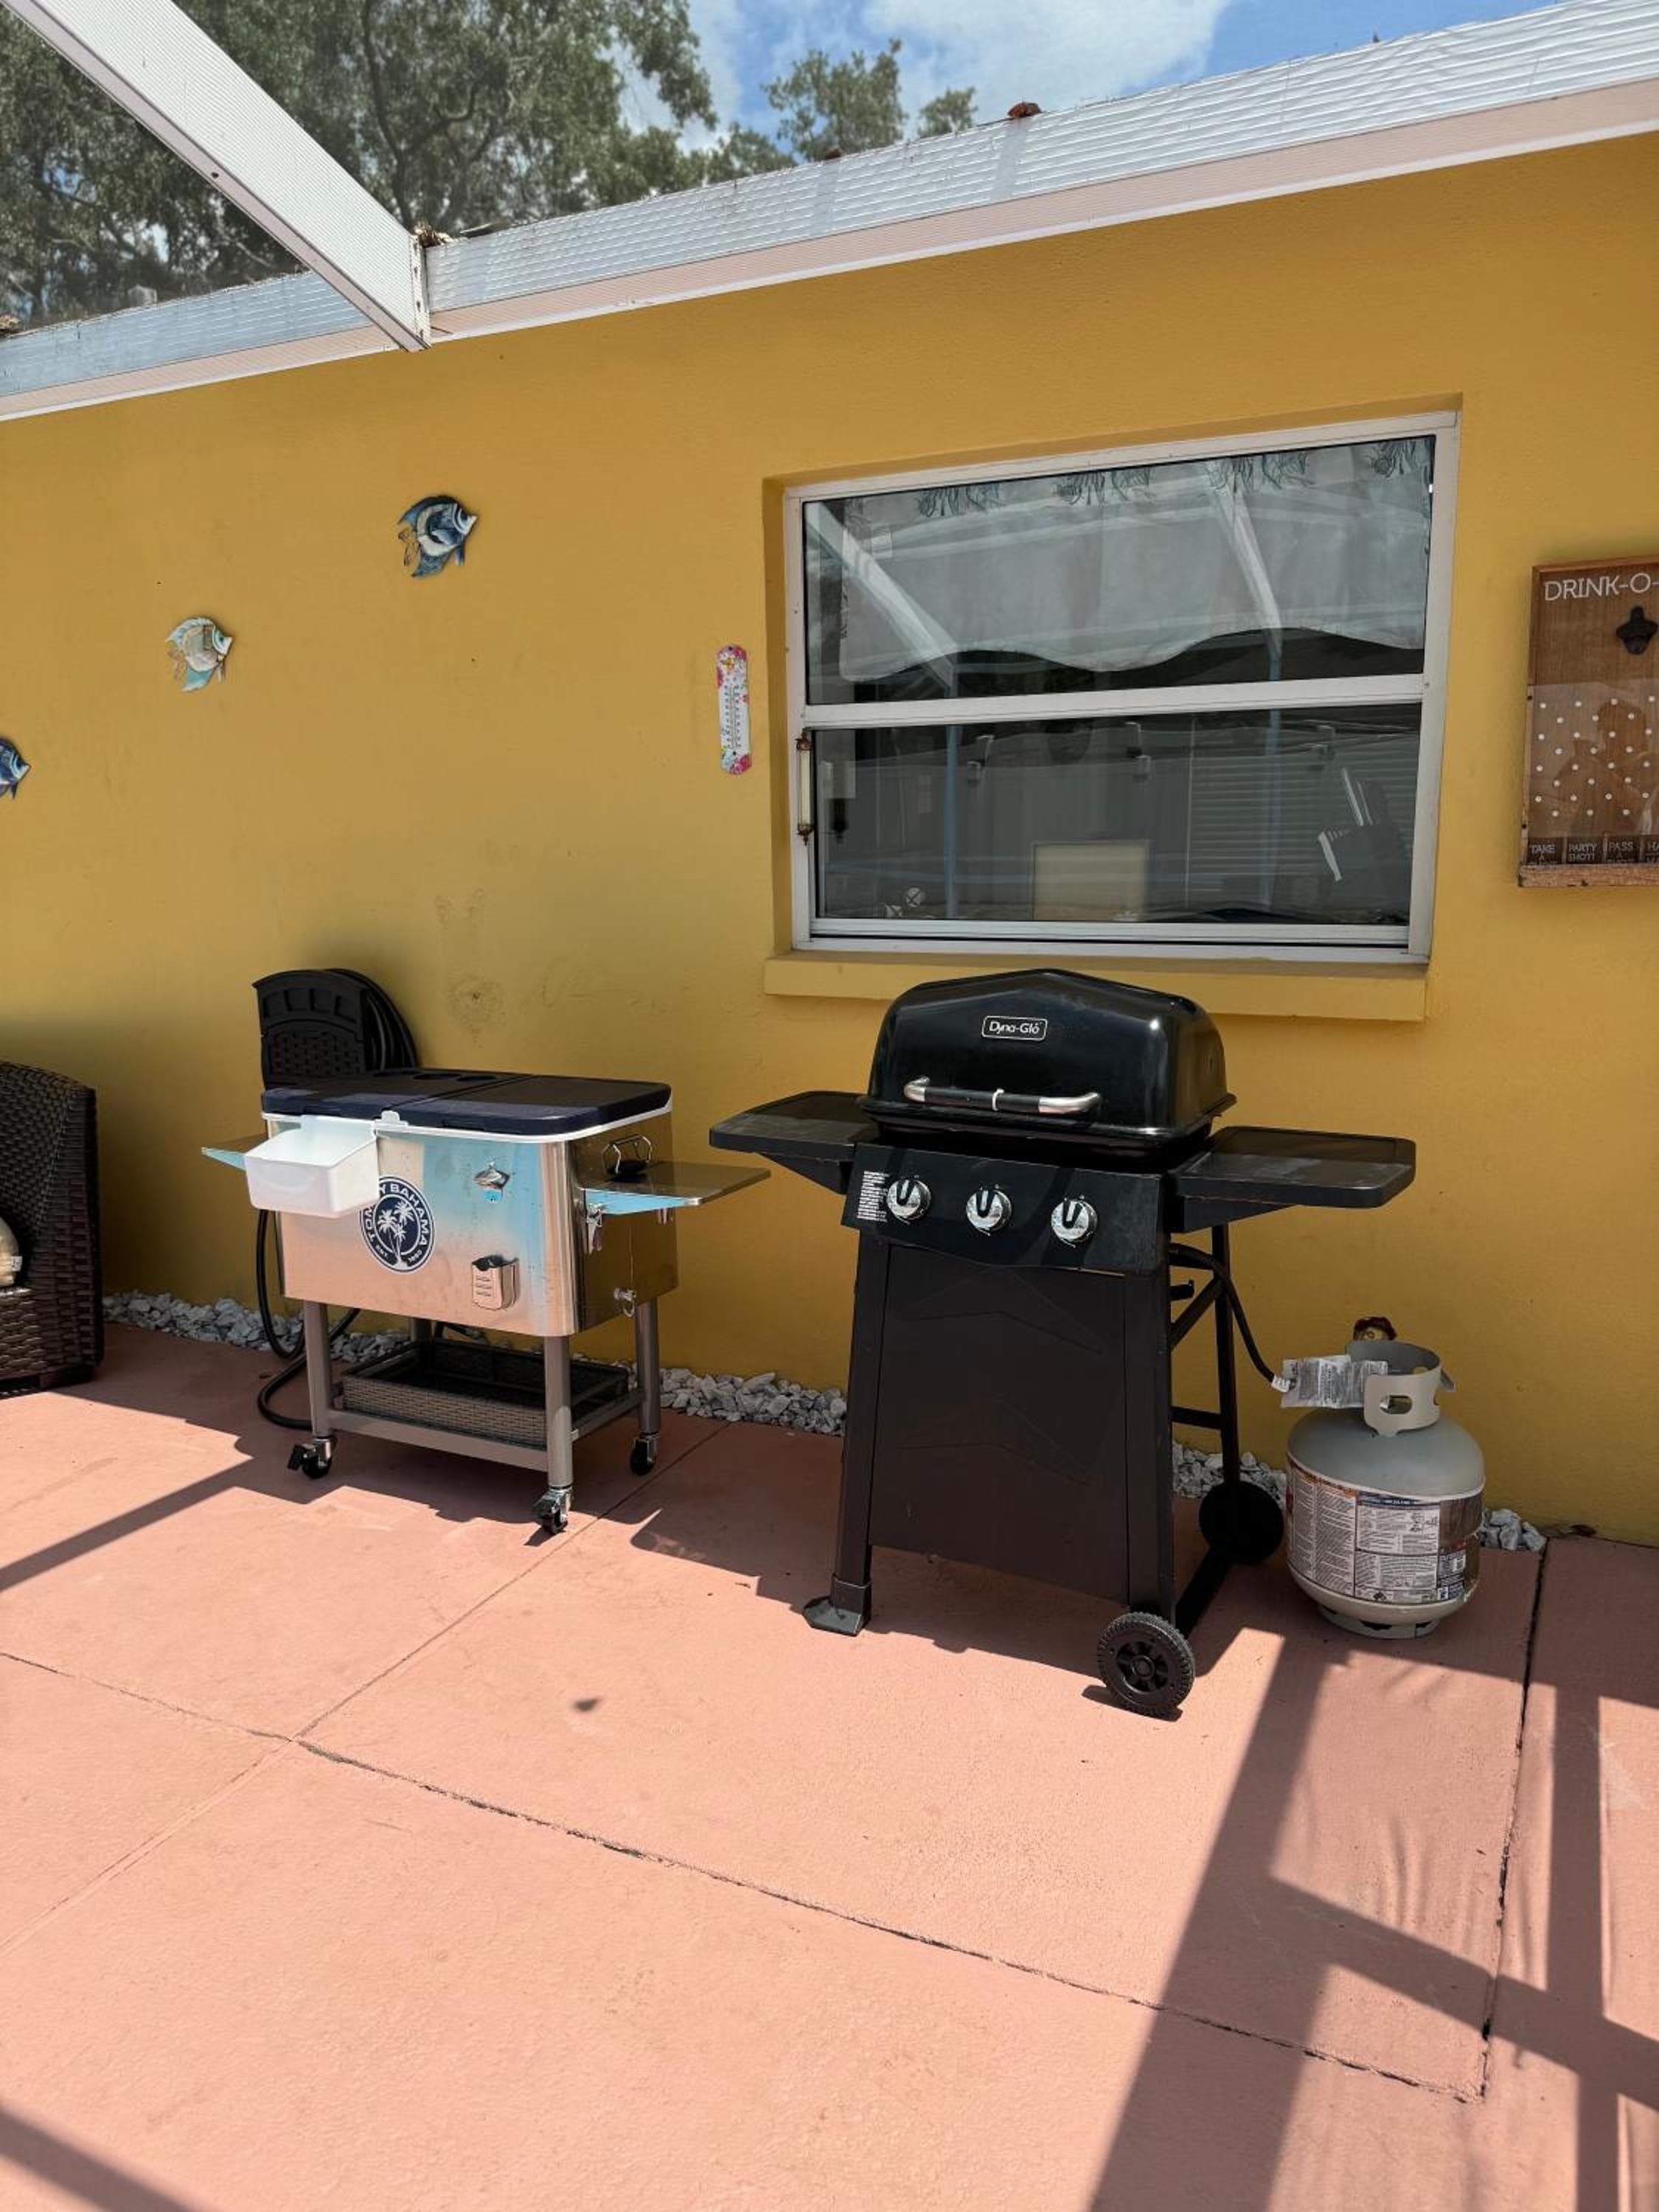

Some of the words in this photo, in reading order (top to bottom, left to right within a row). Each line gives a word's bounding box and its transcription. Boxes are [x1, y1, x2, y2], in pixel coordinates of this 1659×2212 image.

[1530, 844, 1556, 854] TAKE
[1568, 844, 1597, 852] PARTY
[389, 1183, 429, 1245] BAHAMA
